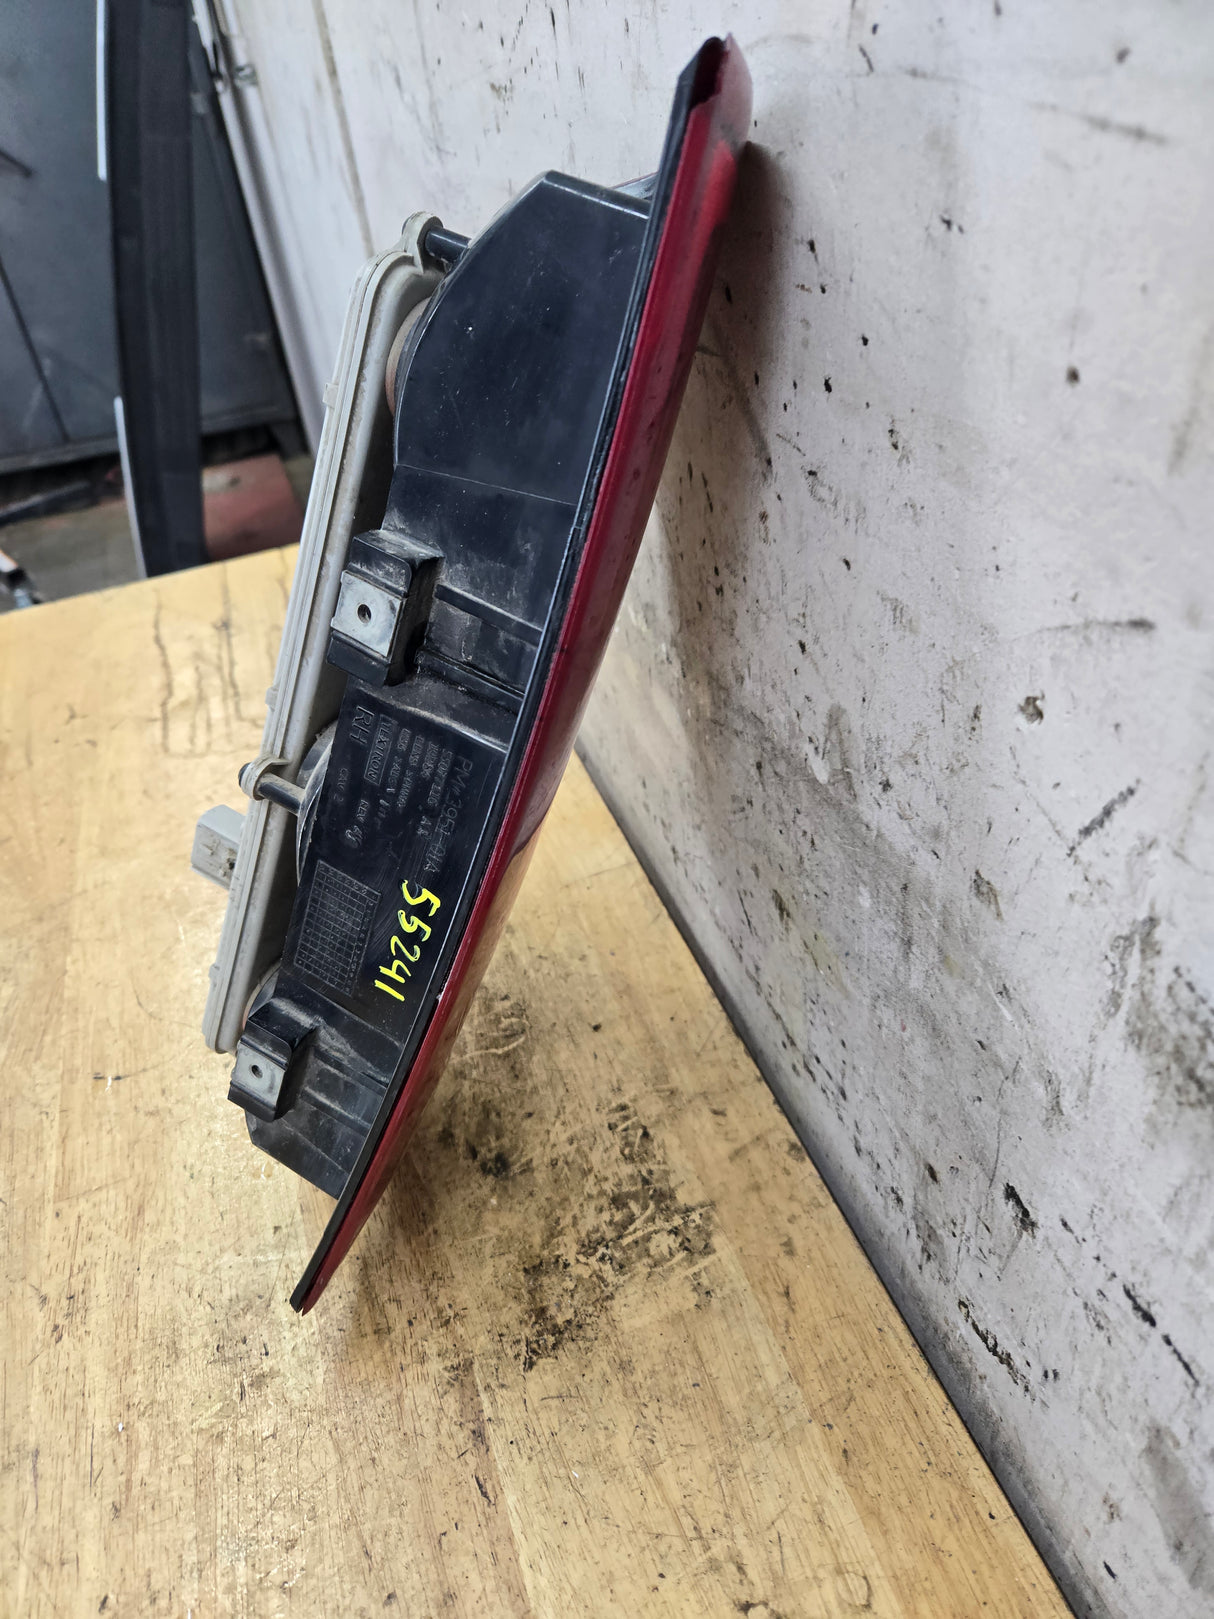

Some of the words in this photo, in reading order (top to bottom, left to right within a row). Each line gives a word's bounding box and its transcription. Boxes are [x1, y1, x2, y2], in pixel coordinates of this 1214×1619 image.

[350, 705, 375, 744] RH
[367, 719, 393, 782] TEXTRON
[356, 799, 370, 823] REV
[374, 879, 441, 1002] 55241
